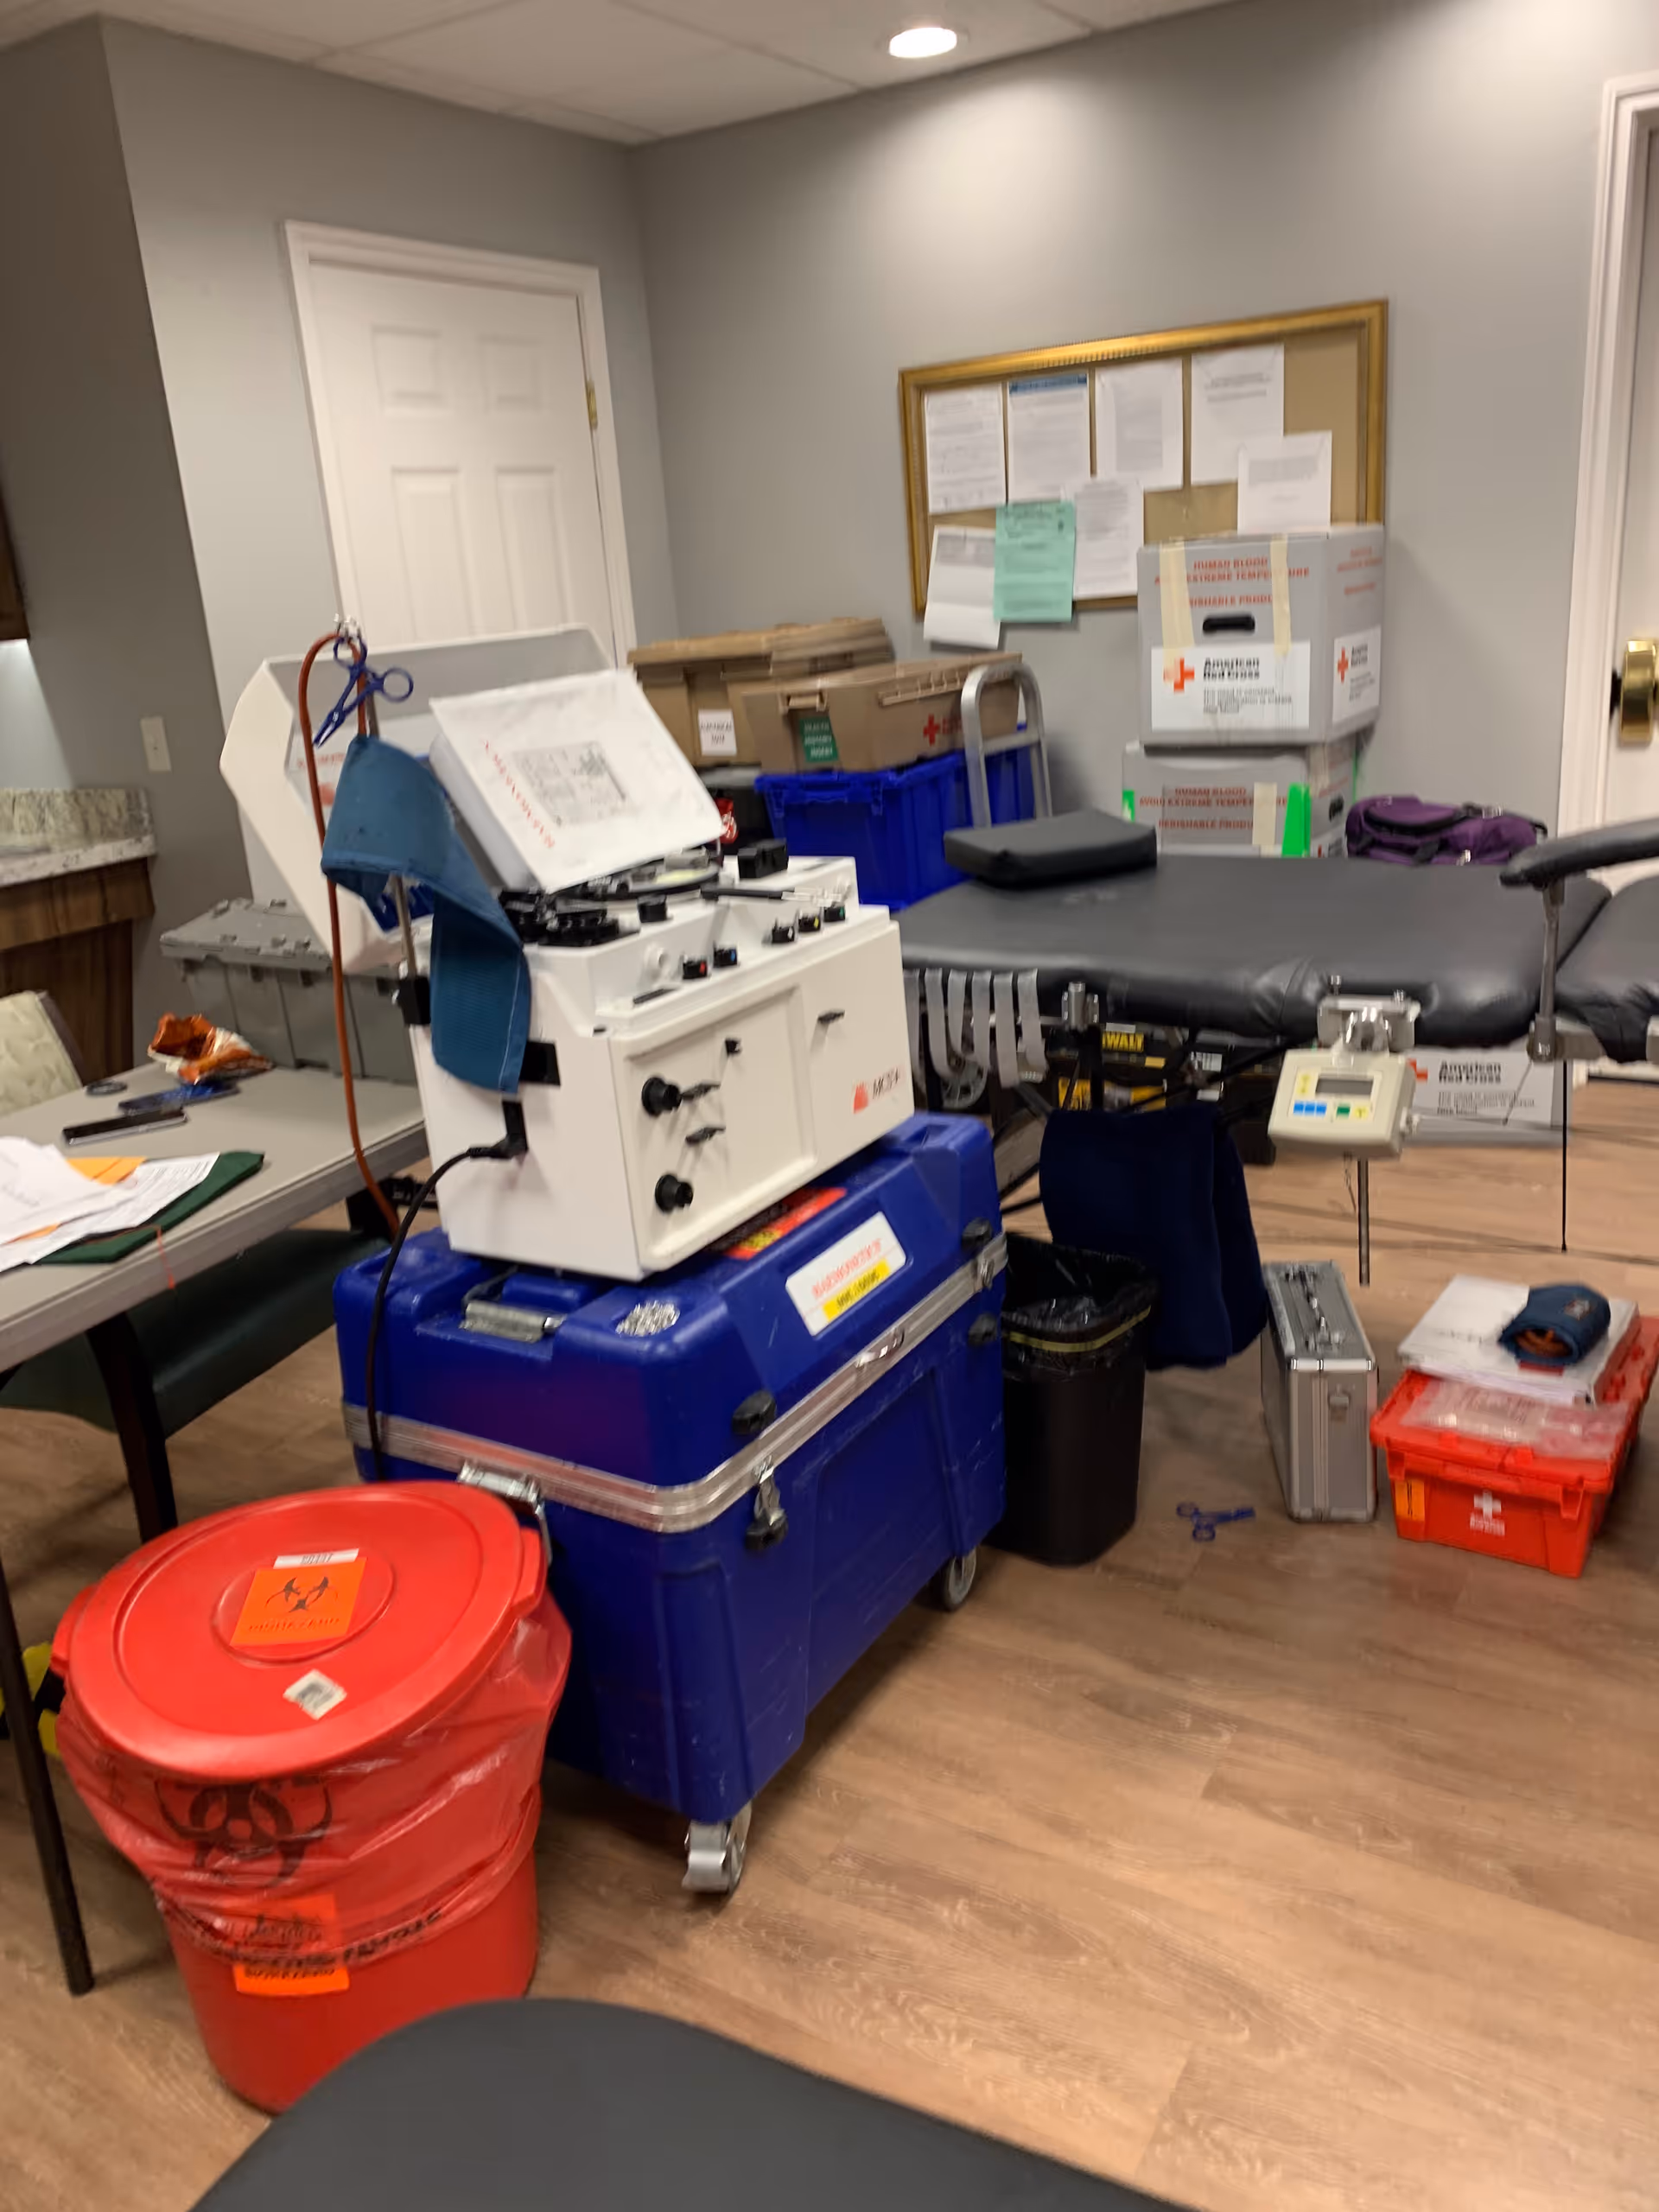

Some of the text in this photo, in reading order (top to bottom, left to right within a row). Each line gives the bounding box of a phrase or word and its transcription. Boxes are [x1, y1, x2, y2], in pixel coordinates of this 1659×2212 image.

[1193, 556, 1268, 571] HUMAN BLOOD
[1236, 566, 1310, 581] TEMPEURE
[1204, 657, 1260, 669] American
[1204, 669, 1260, 680] Red Cross
[1175, 786, 1247, 797] HUMAN BLOOD
[1139, 796, 1165, 807] AVOID
[1167, 796, 1212, 808] EXTREME
[1439, 1062, 1502, 1073] American
[1439, 1072, 1502, 1084] Red Cross
